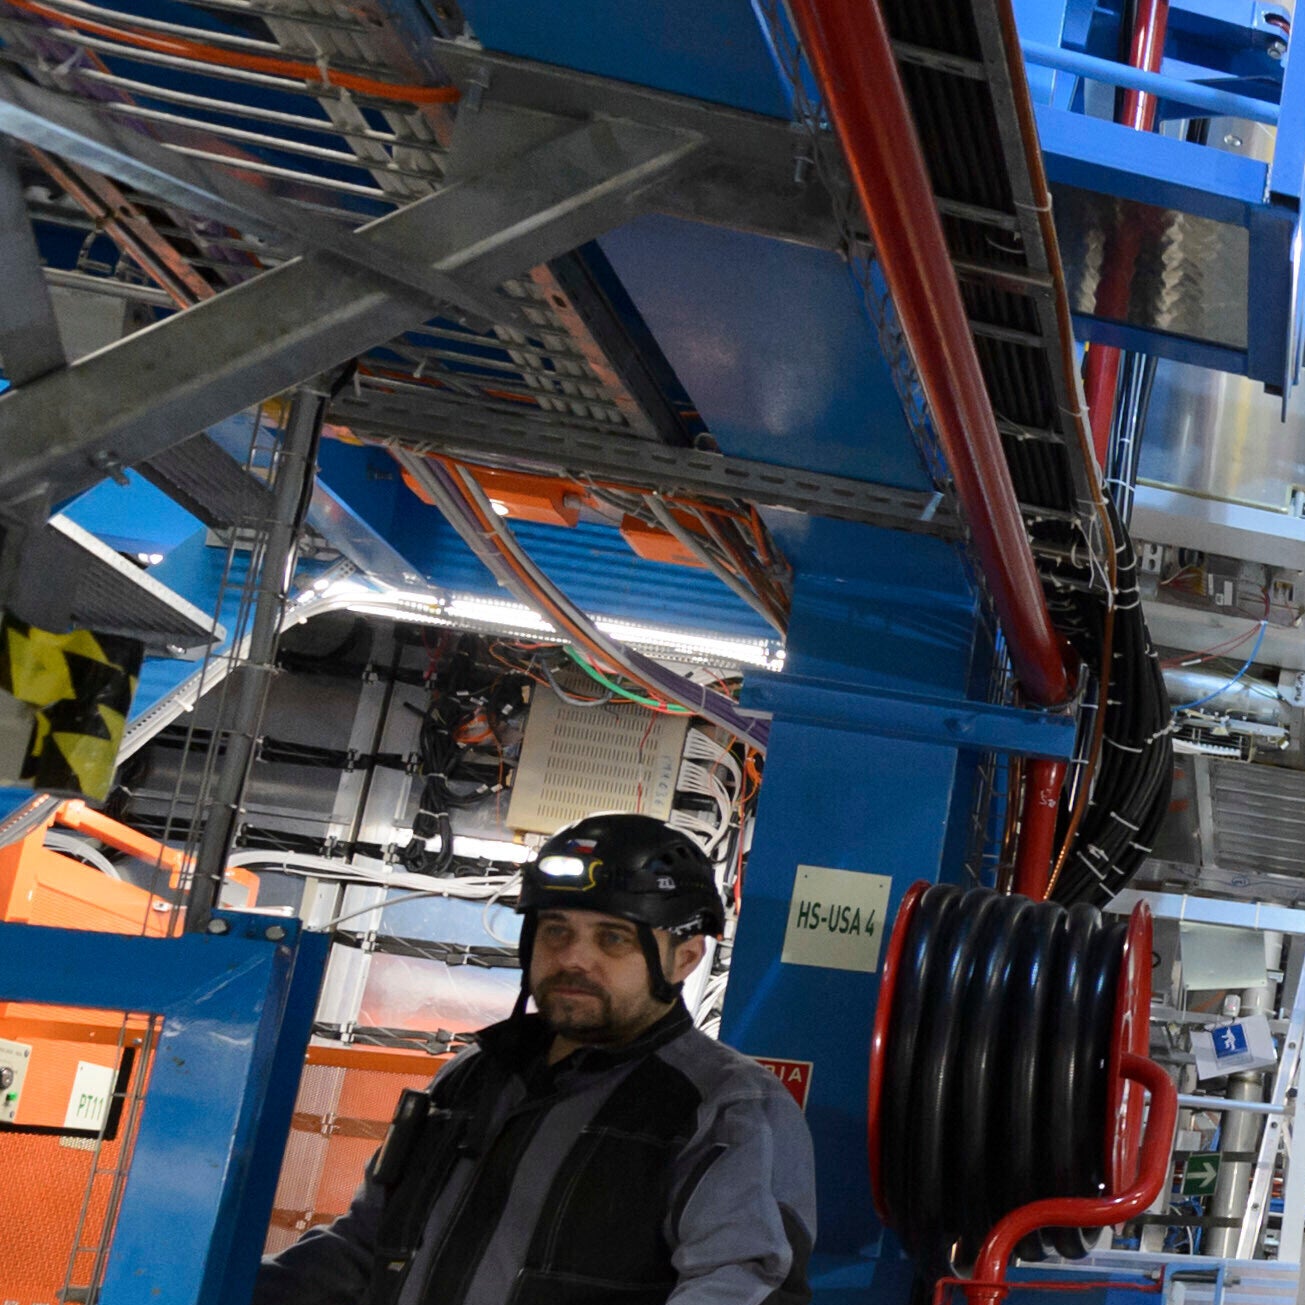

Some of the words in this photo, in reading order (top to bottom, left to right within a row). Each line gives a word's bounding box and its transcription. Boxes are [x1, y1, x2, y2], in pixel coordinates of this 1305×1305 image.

[796, 900, 861, 935] HS-USA
[865, 909, 876, 937] 4
[76, 1093, 104, 1121] PT11
